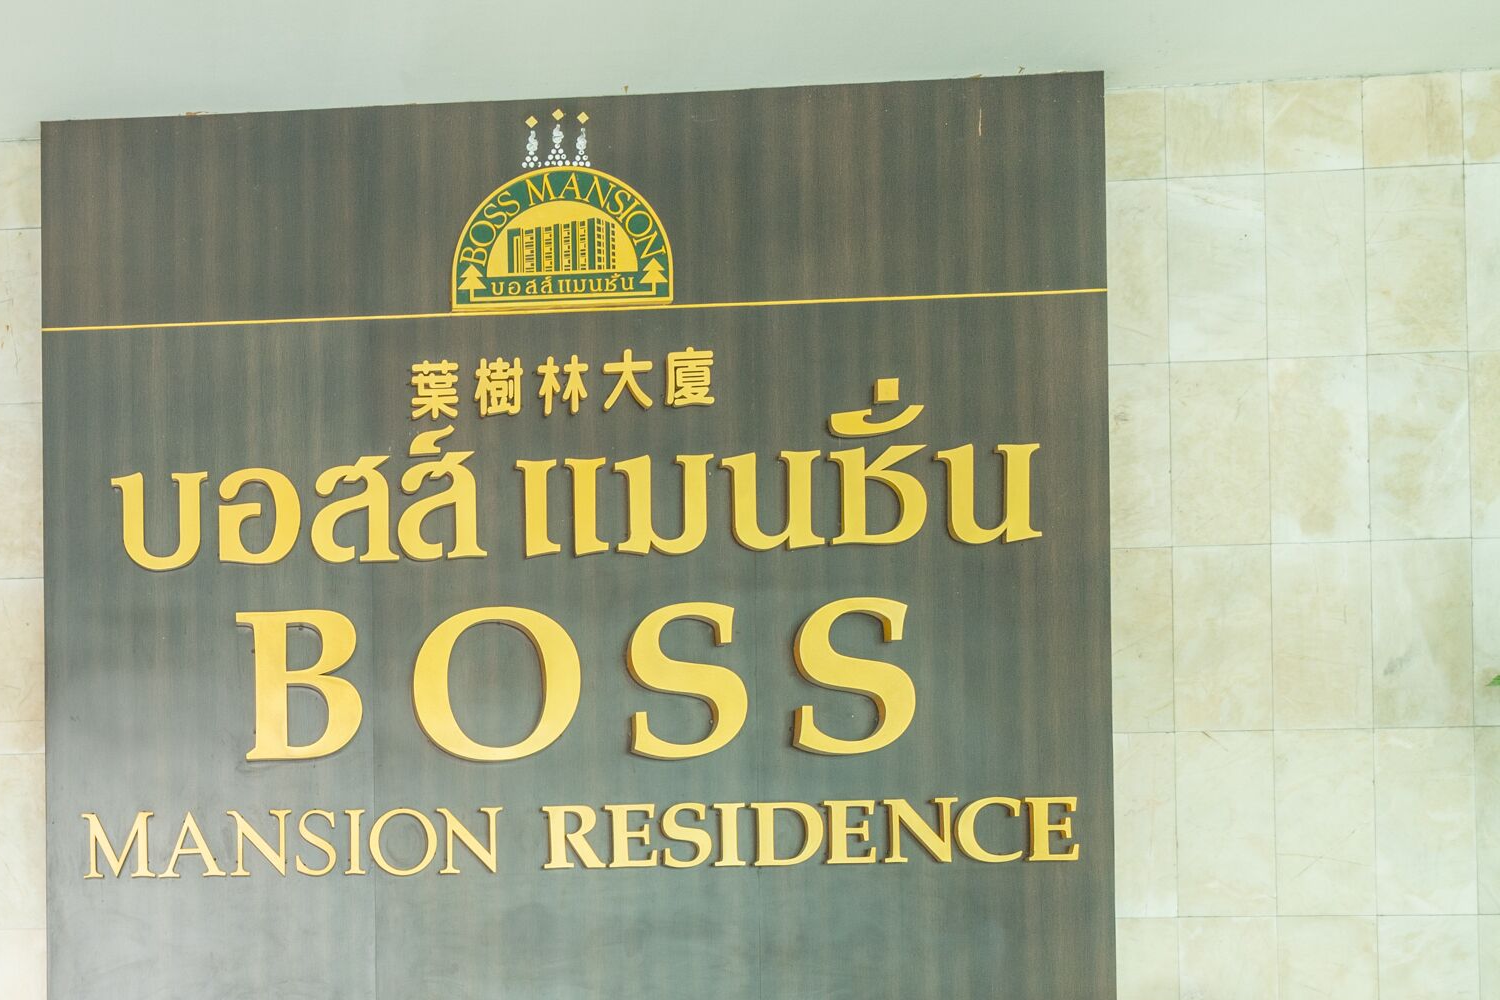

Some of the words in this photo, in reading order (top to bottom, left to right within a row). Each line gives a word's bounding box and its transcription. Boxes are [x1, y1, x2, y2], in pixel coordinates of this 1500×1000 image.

[460, 191, 521, 267] BOSS
[525, 172, 667, 260] MANSION
[411, 346, 715, 420] 葉樹林大廈
[110, 424, 487, 571] บอสส์
[514, 378, 1043, 557] แมนชั่น
[236, 597, 917, 761] BOSS
[83, 806, 502, 879] MANSION
[543, 796, 1080, 869] RESIDENCE
